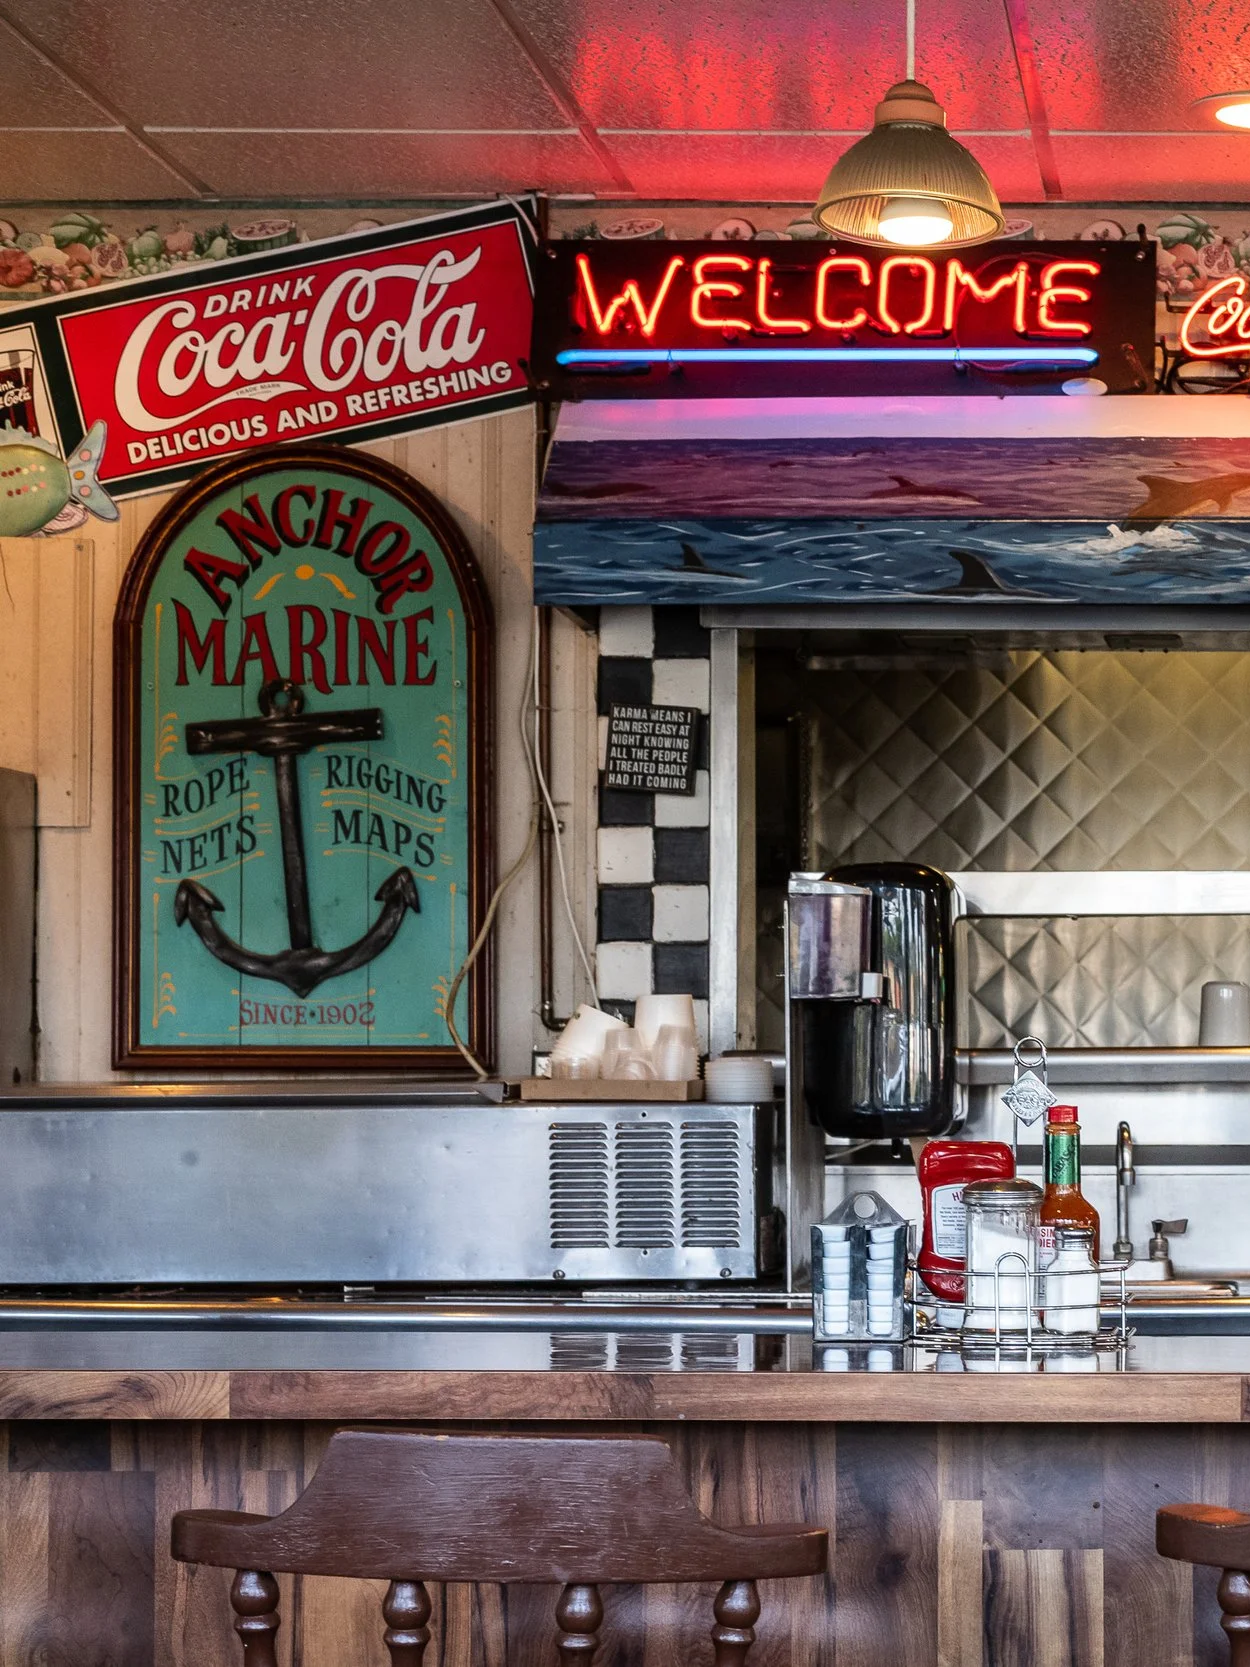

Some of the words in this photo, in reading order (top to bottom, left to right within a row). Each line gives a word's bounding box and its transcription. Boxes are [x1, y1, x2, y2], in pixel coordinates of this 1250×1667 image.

[203, 275, 316, 318] DRINK
[575, 252, 1101, 337] WELCOME
[126, 416, 268, 464] DELICIOUS
[276, 401, 338, 431] AND
[346, 361, 512, 416] REFRESHING
[183, 484, 434, 616] ANCHOR
[170, 596, 438, 695] MARINE
[612, 720, 630, 732] CAN
[631, 721, 653, 734] REST
[655, 723, 677, 735] EASY
[679, 726, 691, 736] AT
[613, 707, 648, 719] KARMA
[650, 709, 685, 722] MEANS
[687, 711, 691, 723] I
[610, 747, 628, 759] ALL
[631, 747, 650, 760] THE
[652, 750, 688, 763] PEOPLE
[611, 734, 641, 746] NIGHT
[643, 736, 689, 750] KNOWING
[160, 756, 250, 817] ROPE
[325, 754, 447, 814] RIGGING
[608, 773, 630, 785] HAD
[632, 775, 643, 786] IT
[646, 775, 687, 789] COMING
[609, 760, 613, 771] I
[616, 761, 656, 774] TREATED
[658, 763, 688, 776] BADLY
[159, 814, 257, 874] NETS
[331, 809, 436, 868] MAPS
[240, 1000, 307, 1025] SINCE
